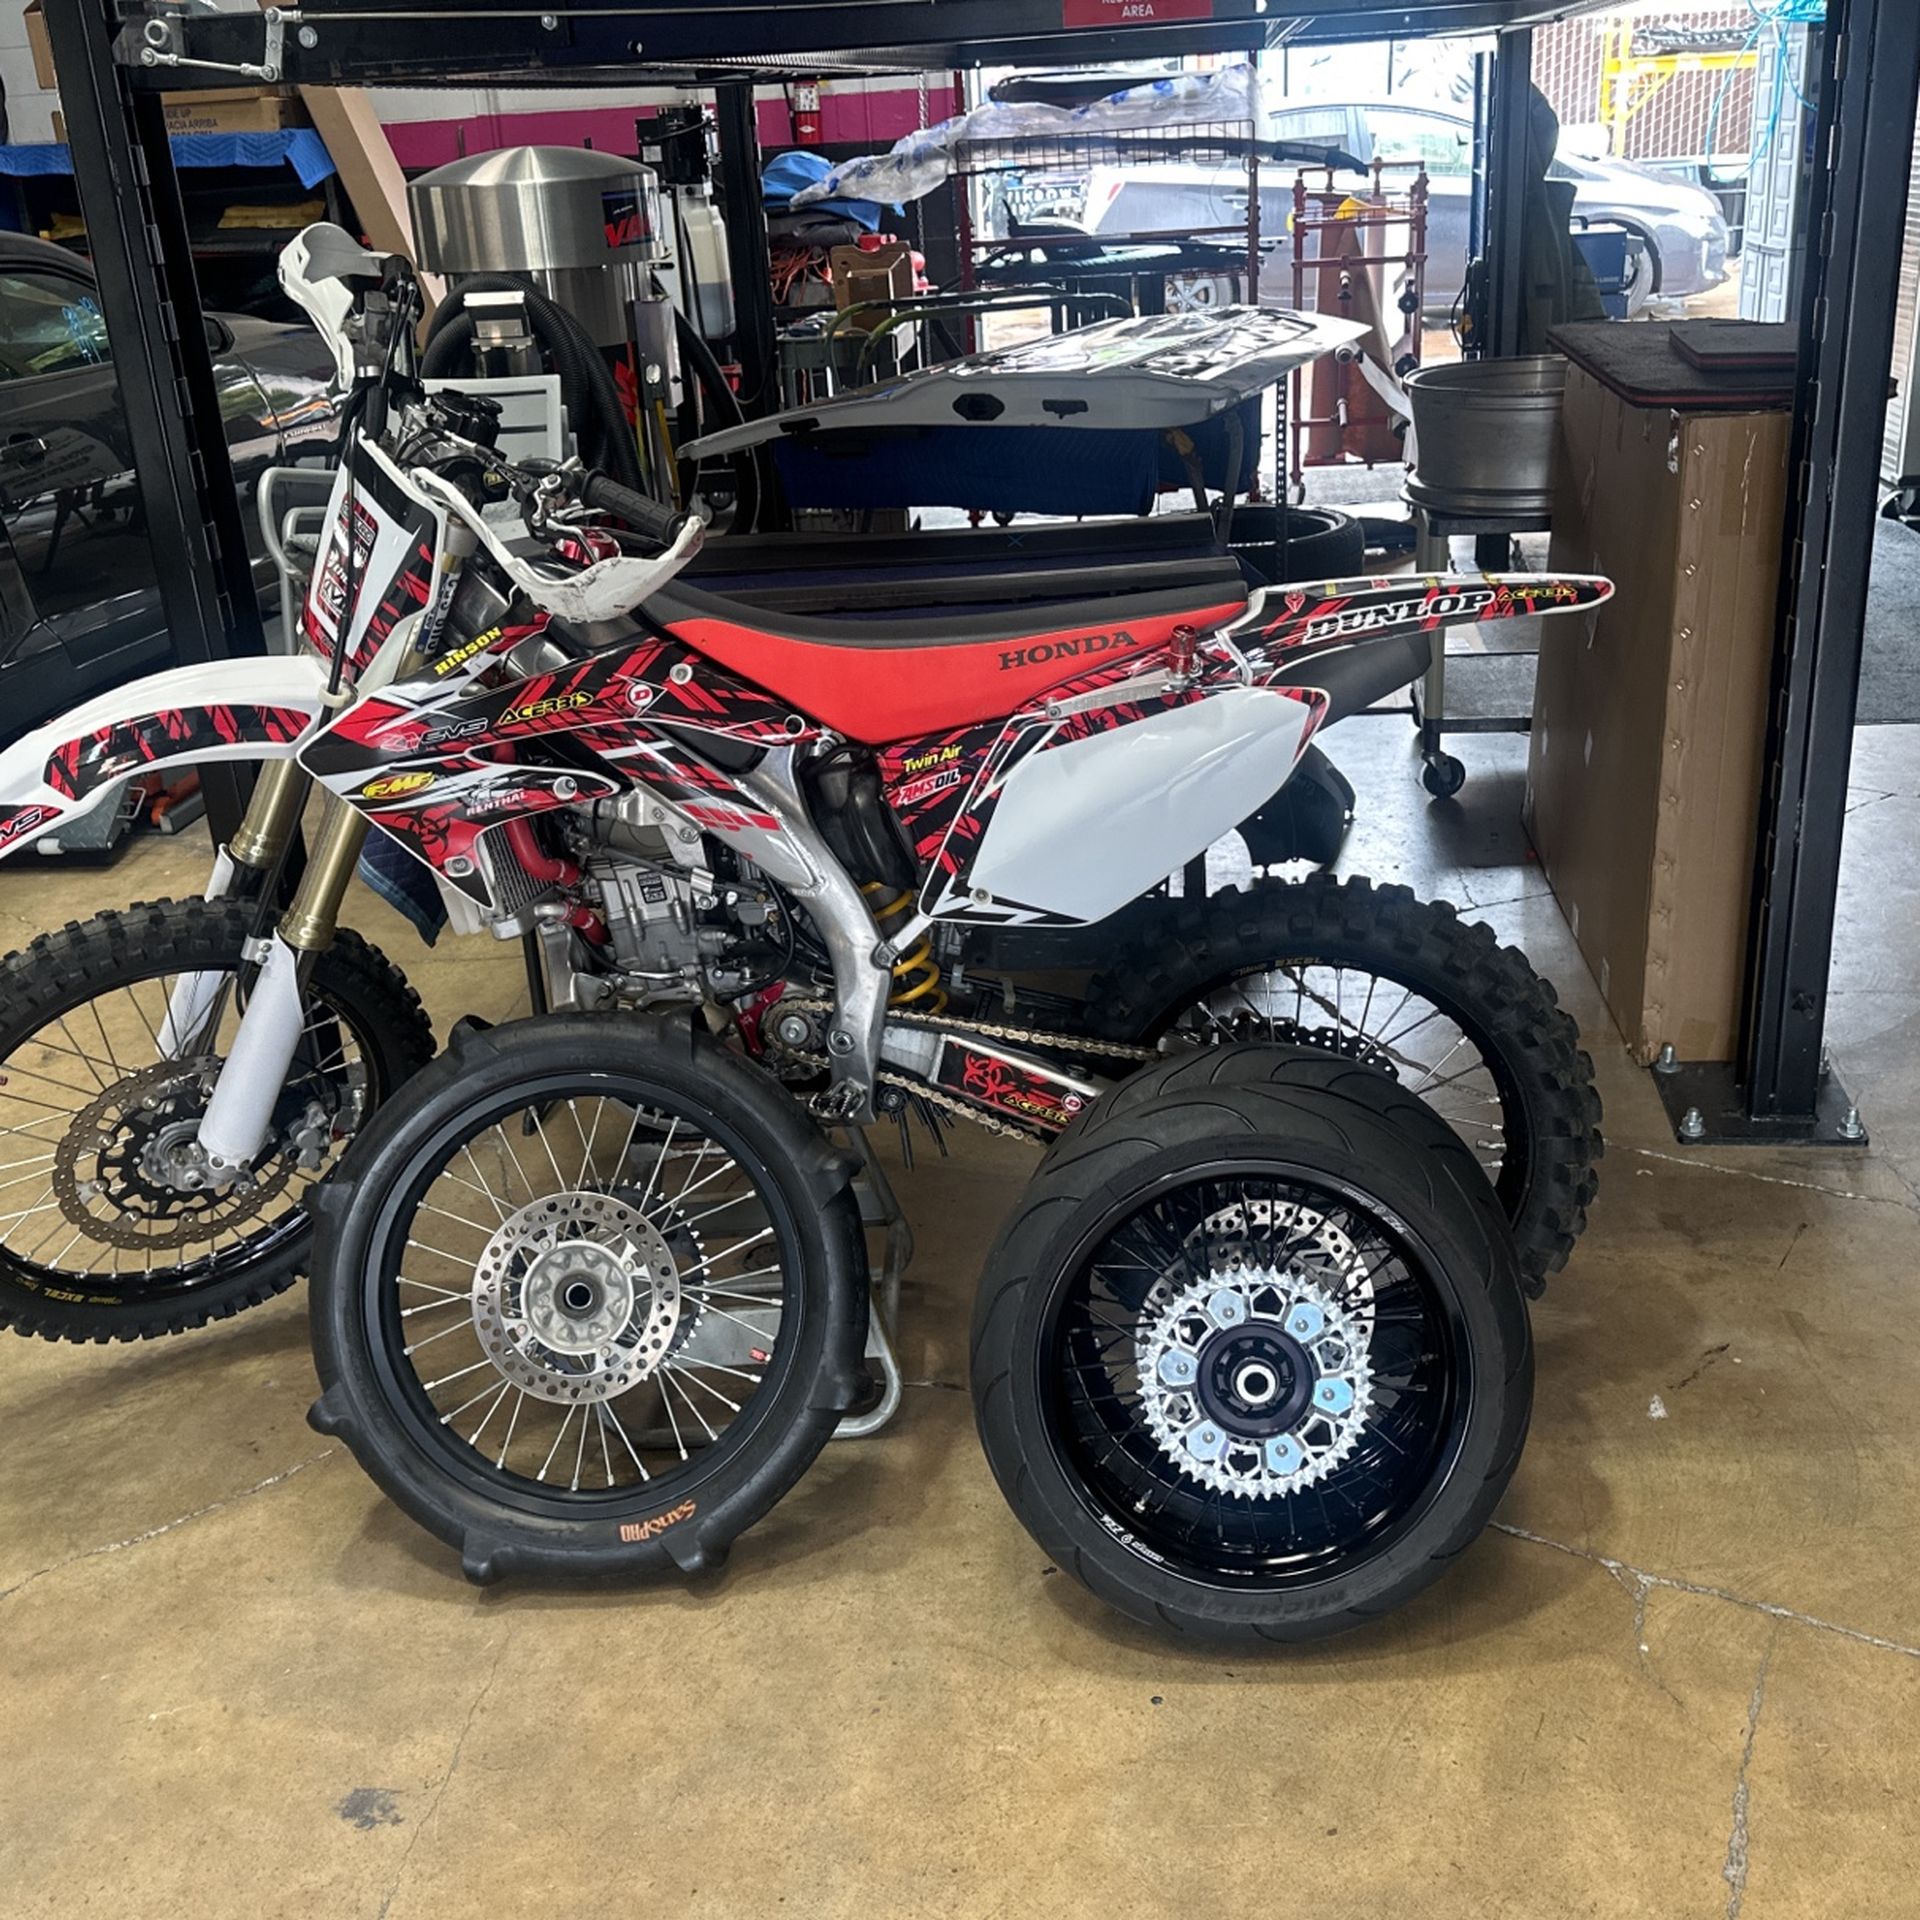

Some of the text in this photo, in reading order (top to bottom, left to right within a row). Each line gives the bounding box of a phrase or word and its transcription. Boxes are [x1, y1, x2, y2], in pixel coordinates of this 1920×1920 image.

[1122, 4, 1155, 18] AREA
[1302, 590, 1497, 644] DUNLOP
[434, 626, 502, 676] HINSON
[998, 631, 1139, 671] HONDA
[499, 691, 594, 725] ACERBIS
[420, 717, 489, 745] EVS
[903, 744, 963, 772] Twin Air
[363, 771, 435, 800] FMF
[899, 769, 960, 804] AMSOIL
[466, 792, 528, 817] RENTHAL
[0, 806, 42, 840] VS
